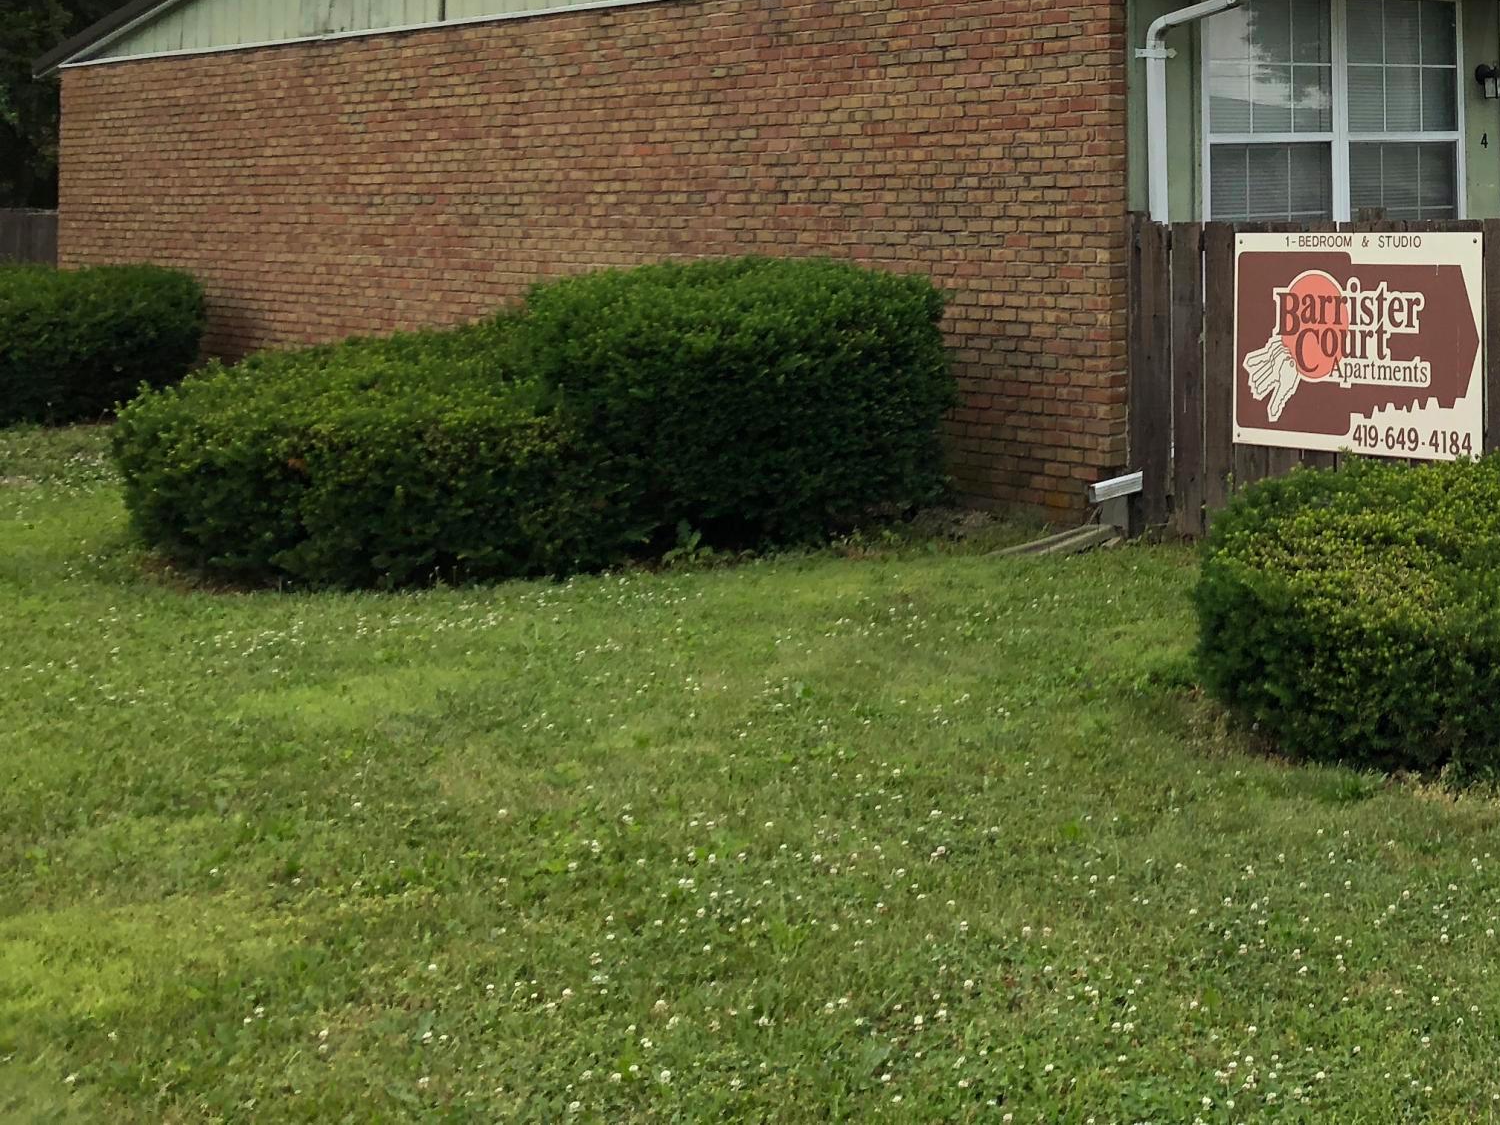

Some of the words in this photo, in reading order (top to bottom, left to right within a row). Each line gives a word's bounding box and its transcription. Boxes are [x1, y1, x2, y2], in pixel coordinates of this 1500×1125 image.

[1480, 132, 1488, 148] 4
[1285, 235, 1352, 248] 1-BEDROOM
[1361, 236, 1369, 248] &
[1378, 235, 1422, 248] STUDIO
[1276, 281, 1421, 336] Barrister
[1295, 321, 1387, 373] Court
[1329, 356, 1428, 384] Apartments
